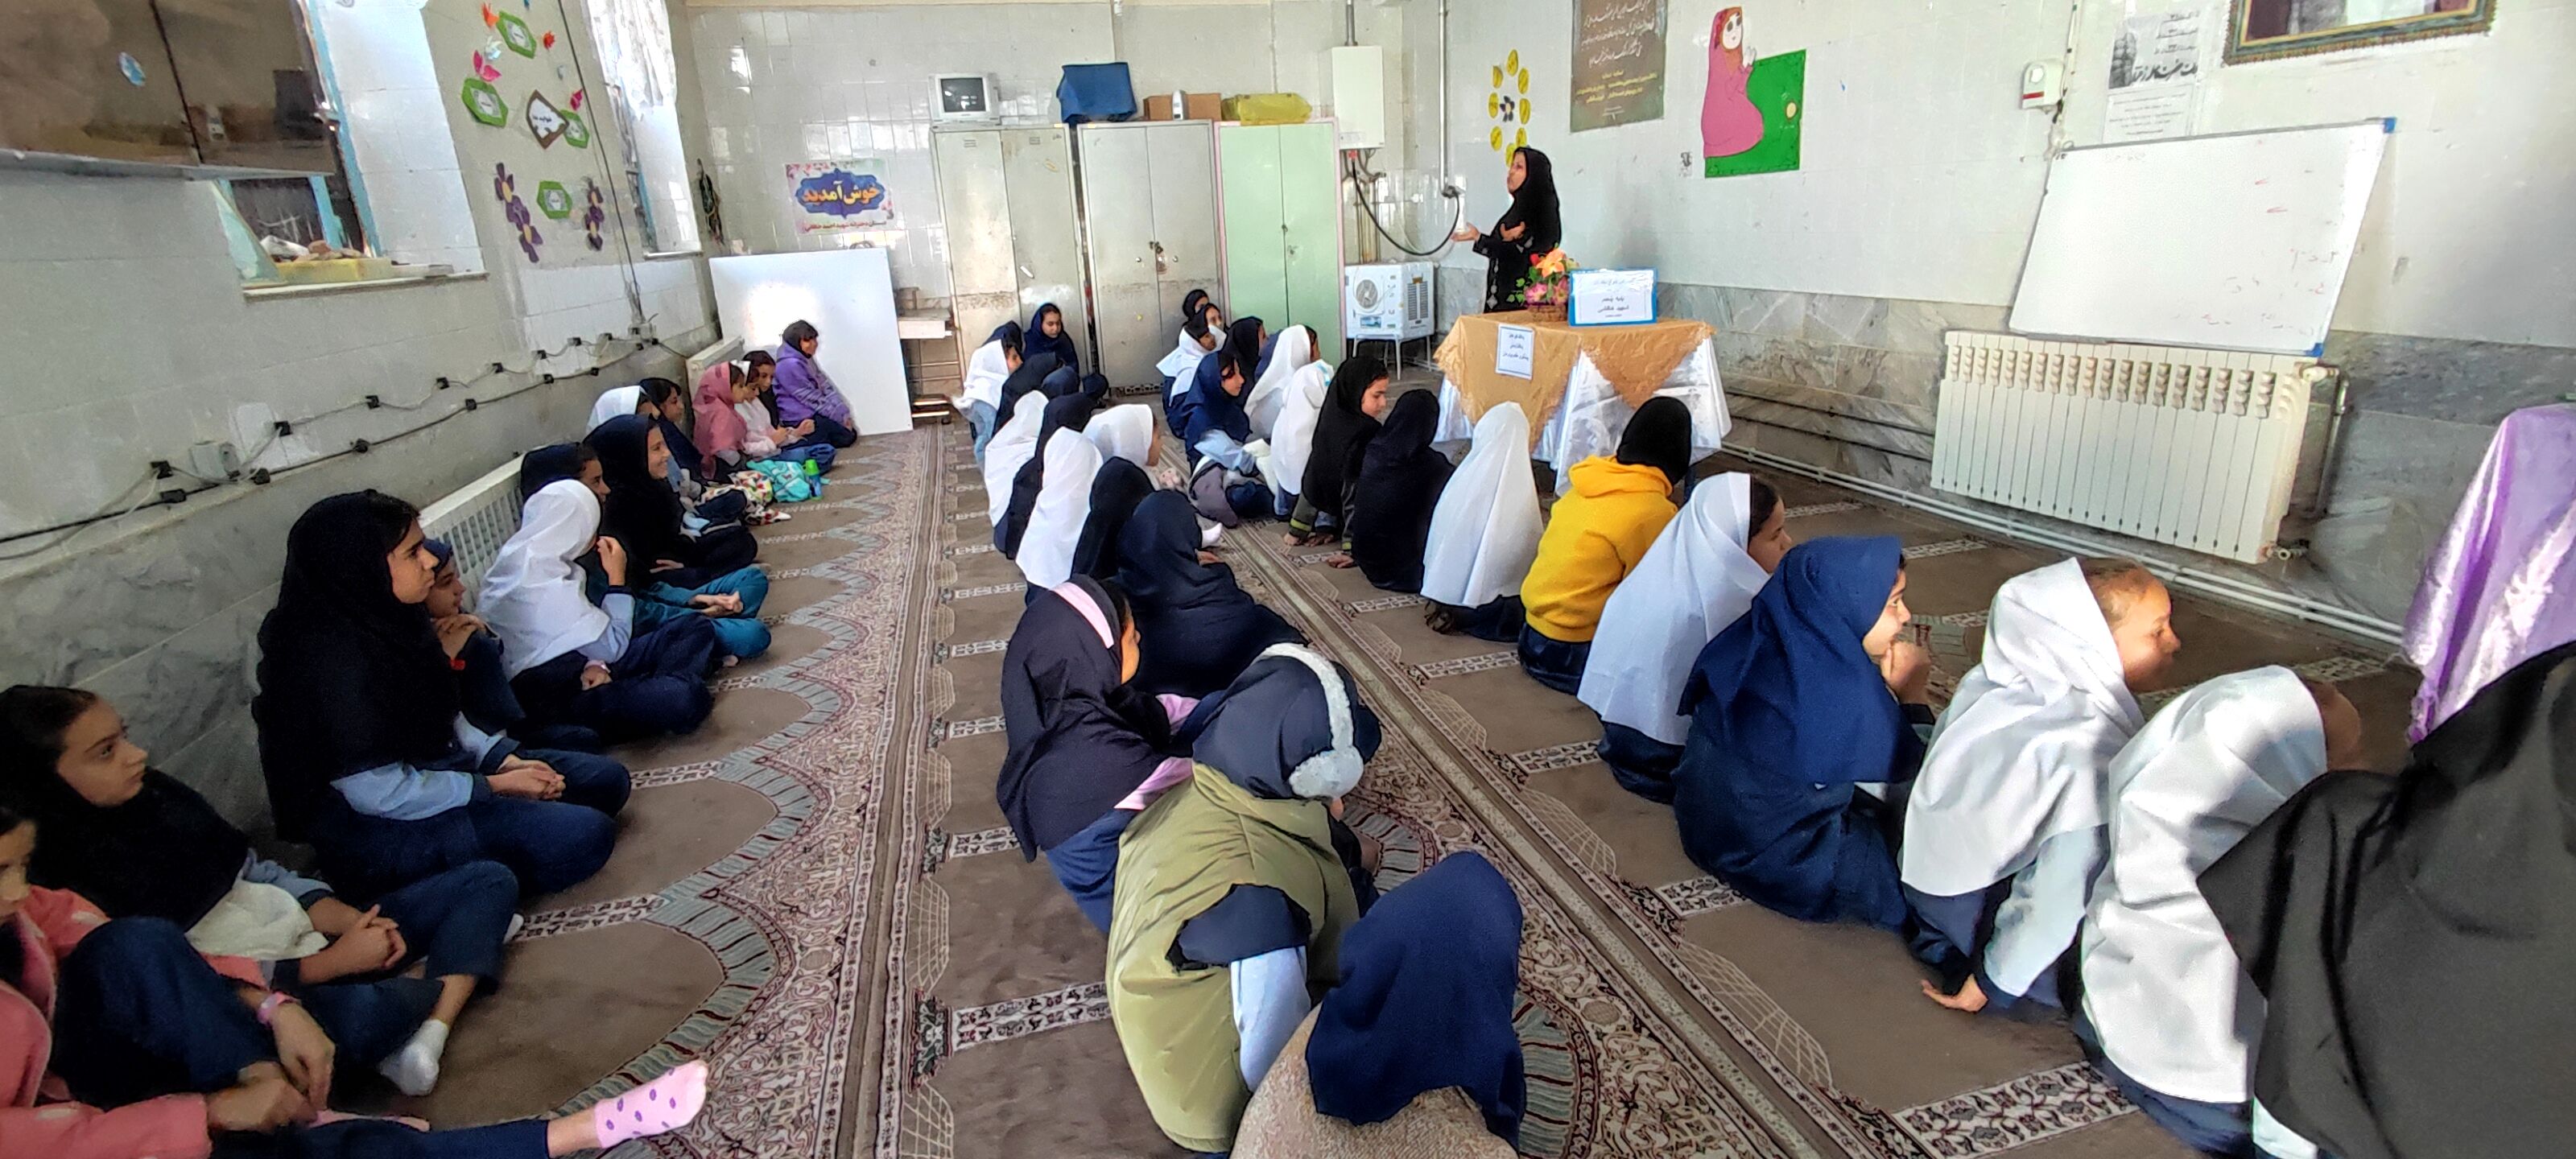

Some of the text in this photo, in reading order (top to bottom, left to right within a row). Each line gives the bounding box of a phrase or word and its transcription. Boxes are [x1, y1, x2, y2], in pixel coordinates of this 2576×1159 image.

[803, 180, 881, 204] خوش آمدید
[850, 221, 868, 229] دخترانه
